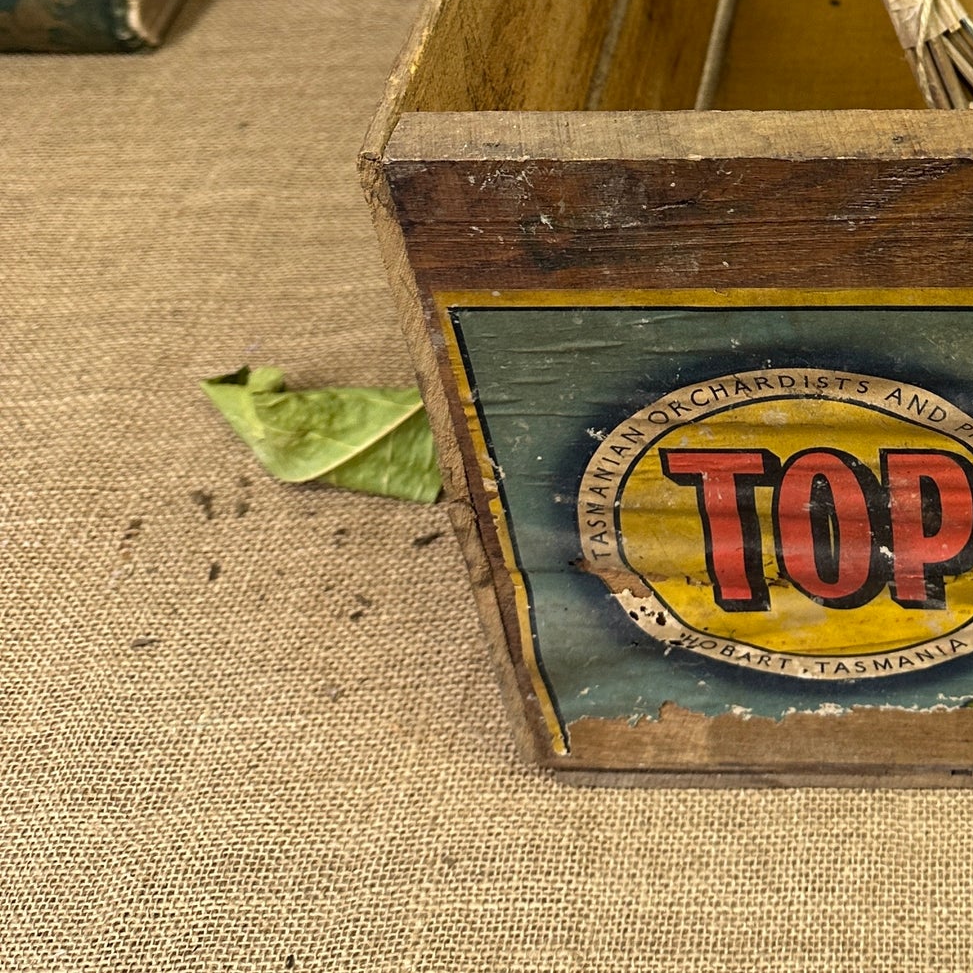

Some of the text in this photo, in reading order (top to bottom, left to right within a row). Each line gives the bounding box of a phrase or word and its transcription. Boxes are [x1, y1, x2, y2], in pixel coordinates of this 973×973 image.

[586, 426, 645, 561] TASMANIAN
[648, 374, 869, 425] ORCHARDISTS
[884, 388, 947, 423] AND
[815, 638, 968, 674] TASMANIA
